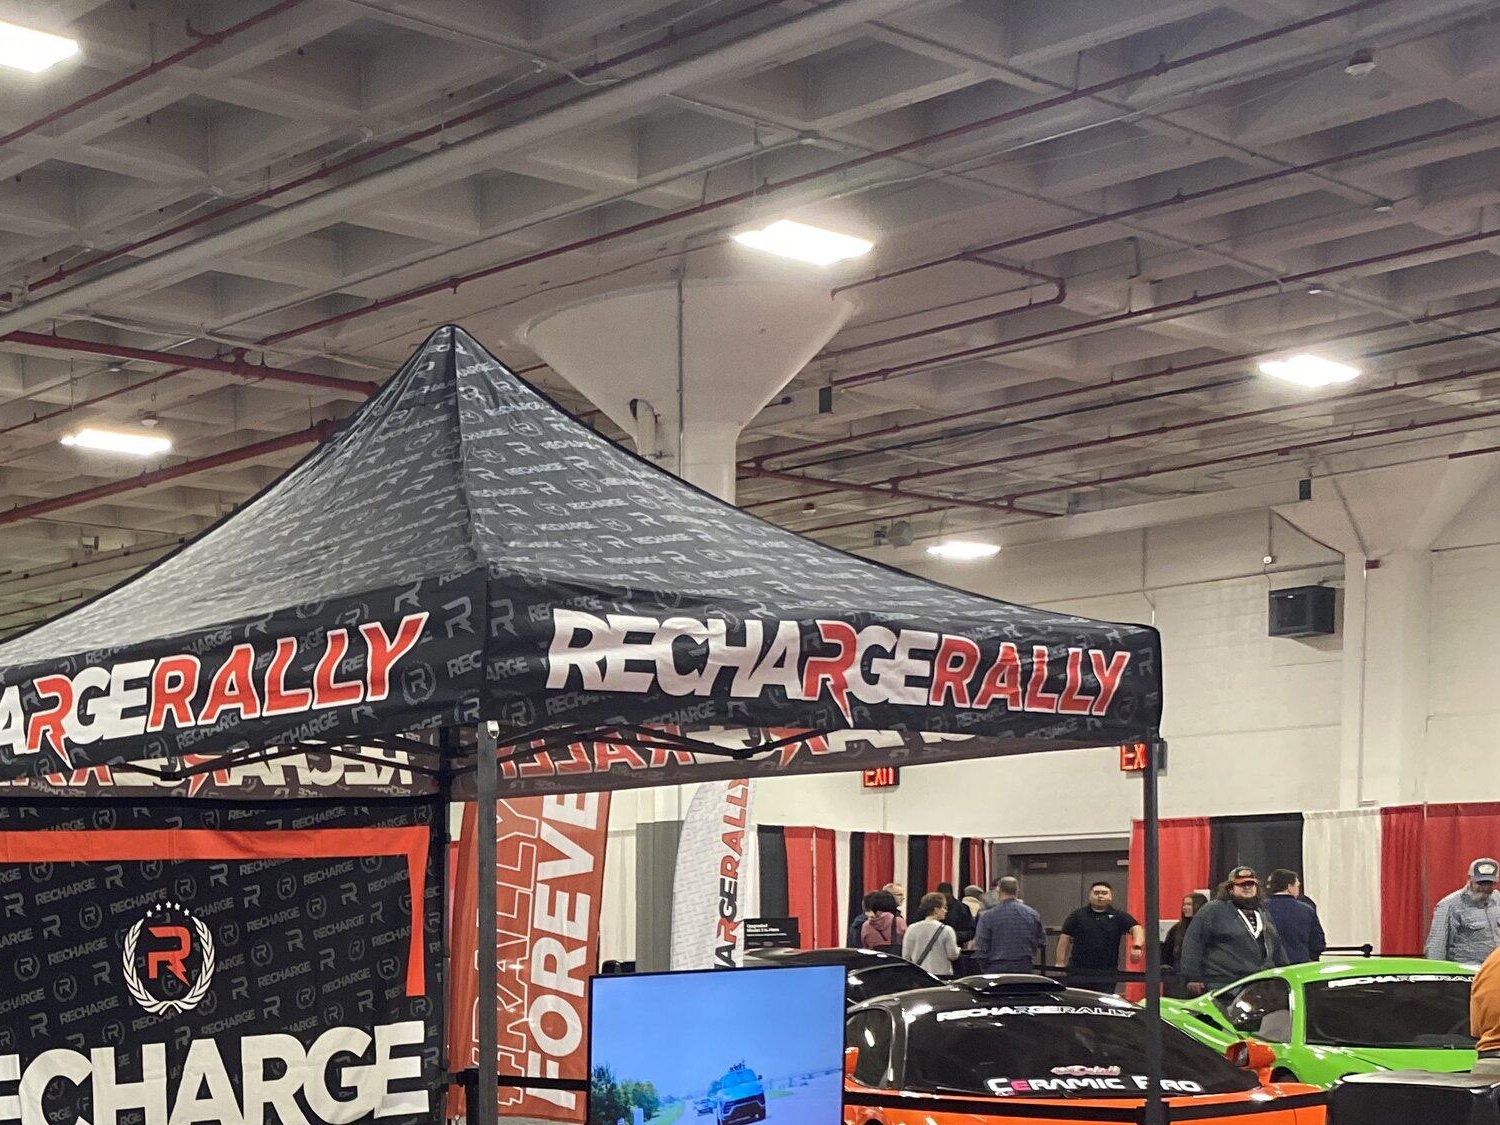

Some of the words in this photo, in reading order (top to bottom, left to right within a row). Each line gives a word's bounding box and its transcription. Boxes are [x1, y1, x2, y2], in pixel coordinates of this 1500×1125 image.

[1121, 745, 1146, 770] EX
[865, 768, 895, 787] EXIT
[368, 869, 408, 893] RECHARG
[372, 926, 411, 947] RECHA
[525, 792, 599, 1111] FOREVE
[986, 1076, 1125, 1093] CERAMIC
